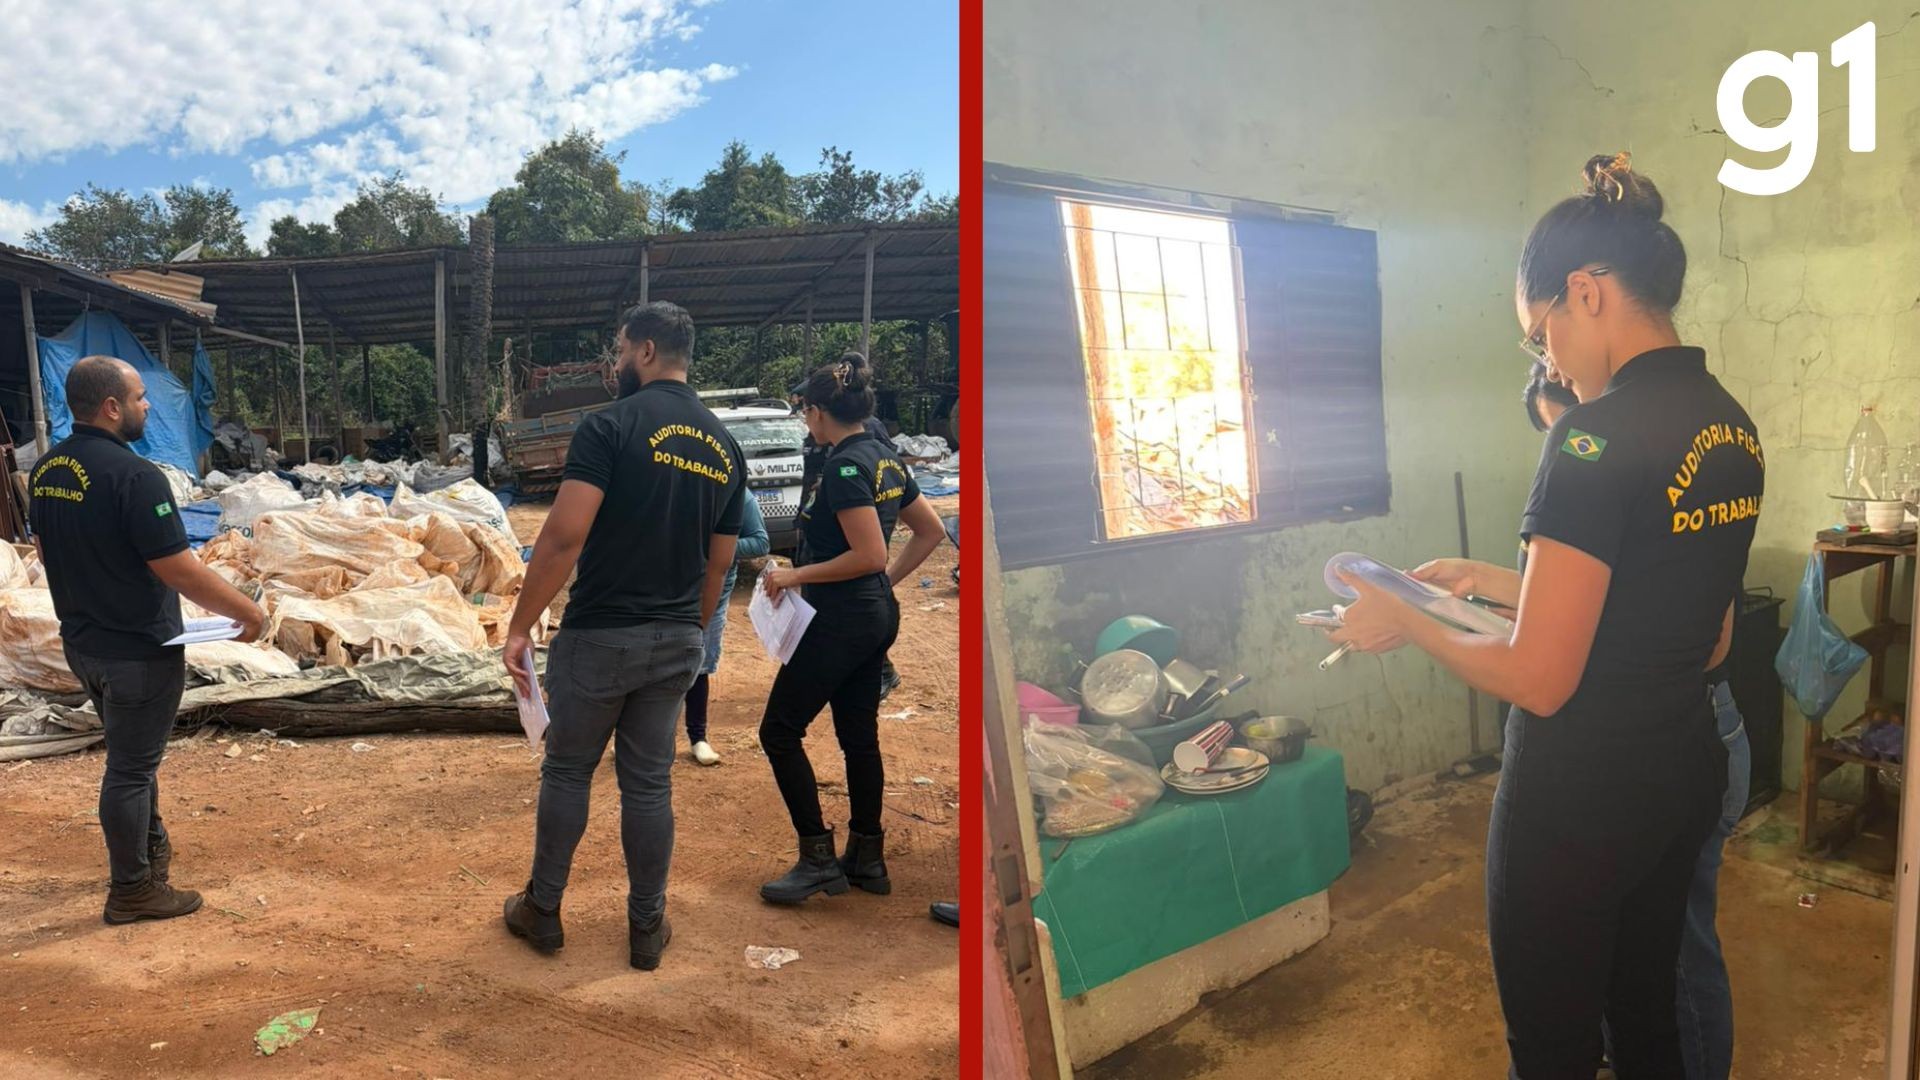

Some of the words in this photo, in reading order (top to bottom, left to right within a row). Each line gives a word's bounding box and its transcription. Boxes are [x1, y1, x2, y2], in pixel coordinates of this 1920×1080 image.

[648, 424, 703, 448] AUDITORIA
[705, 434, 733, 474] FISCAL
[1667, 423, 1734, 508] AUDITORIA
[1736, 426, 1764, 469] FISC
[34, 456, 69, 486] AUDITORIA
[69, 458, 91, 490] FISCAL
[654, 451, 671, 464] DO
[672, 455, 729, 484] TRABALHO
[767, 463, 803, 474] MILITA
[34, 486, 43, 497] DO
[45, 486, 84, 502] TRABALHO
[1672, 508, 1704, 533] DO
[1708, 495, 1763, 527] TRABAL
